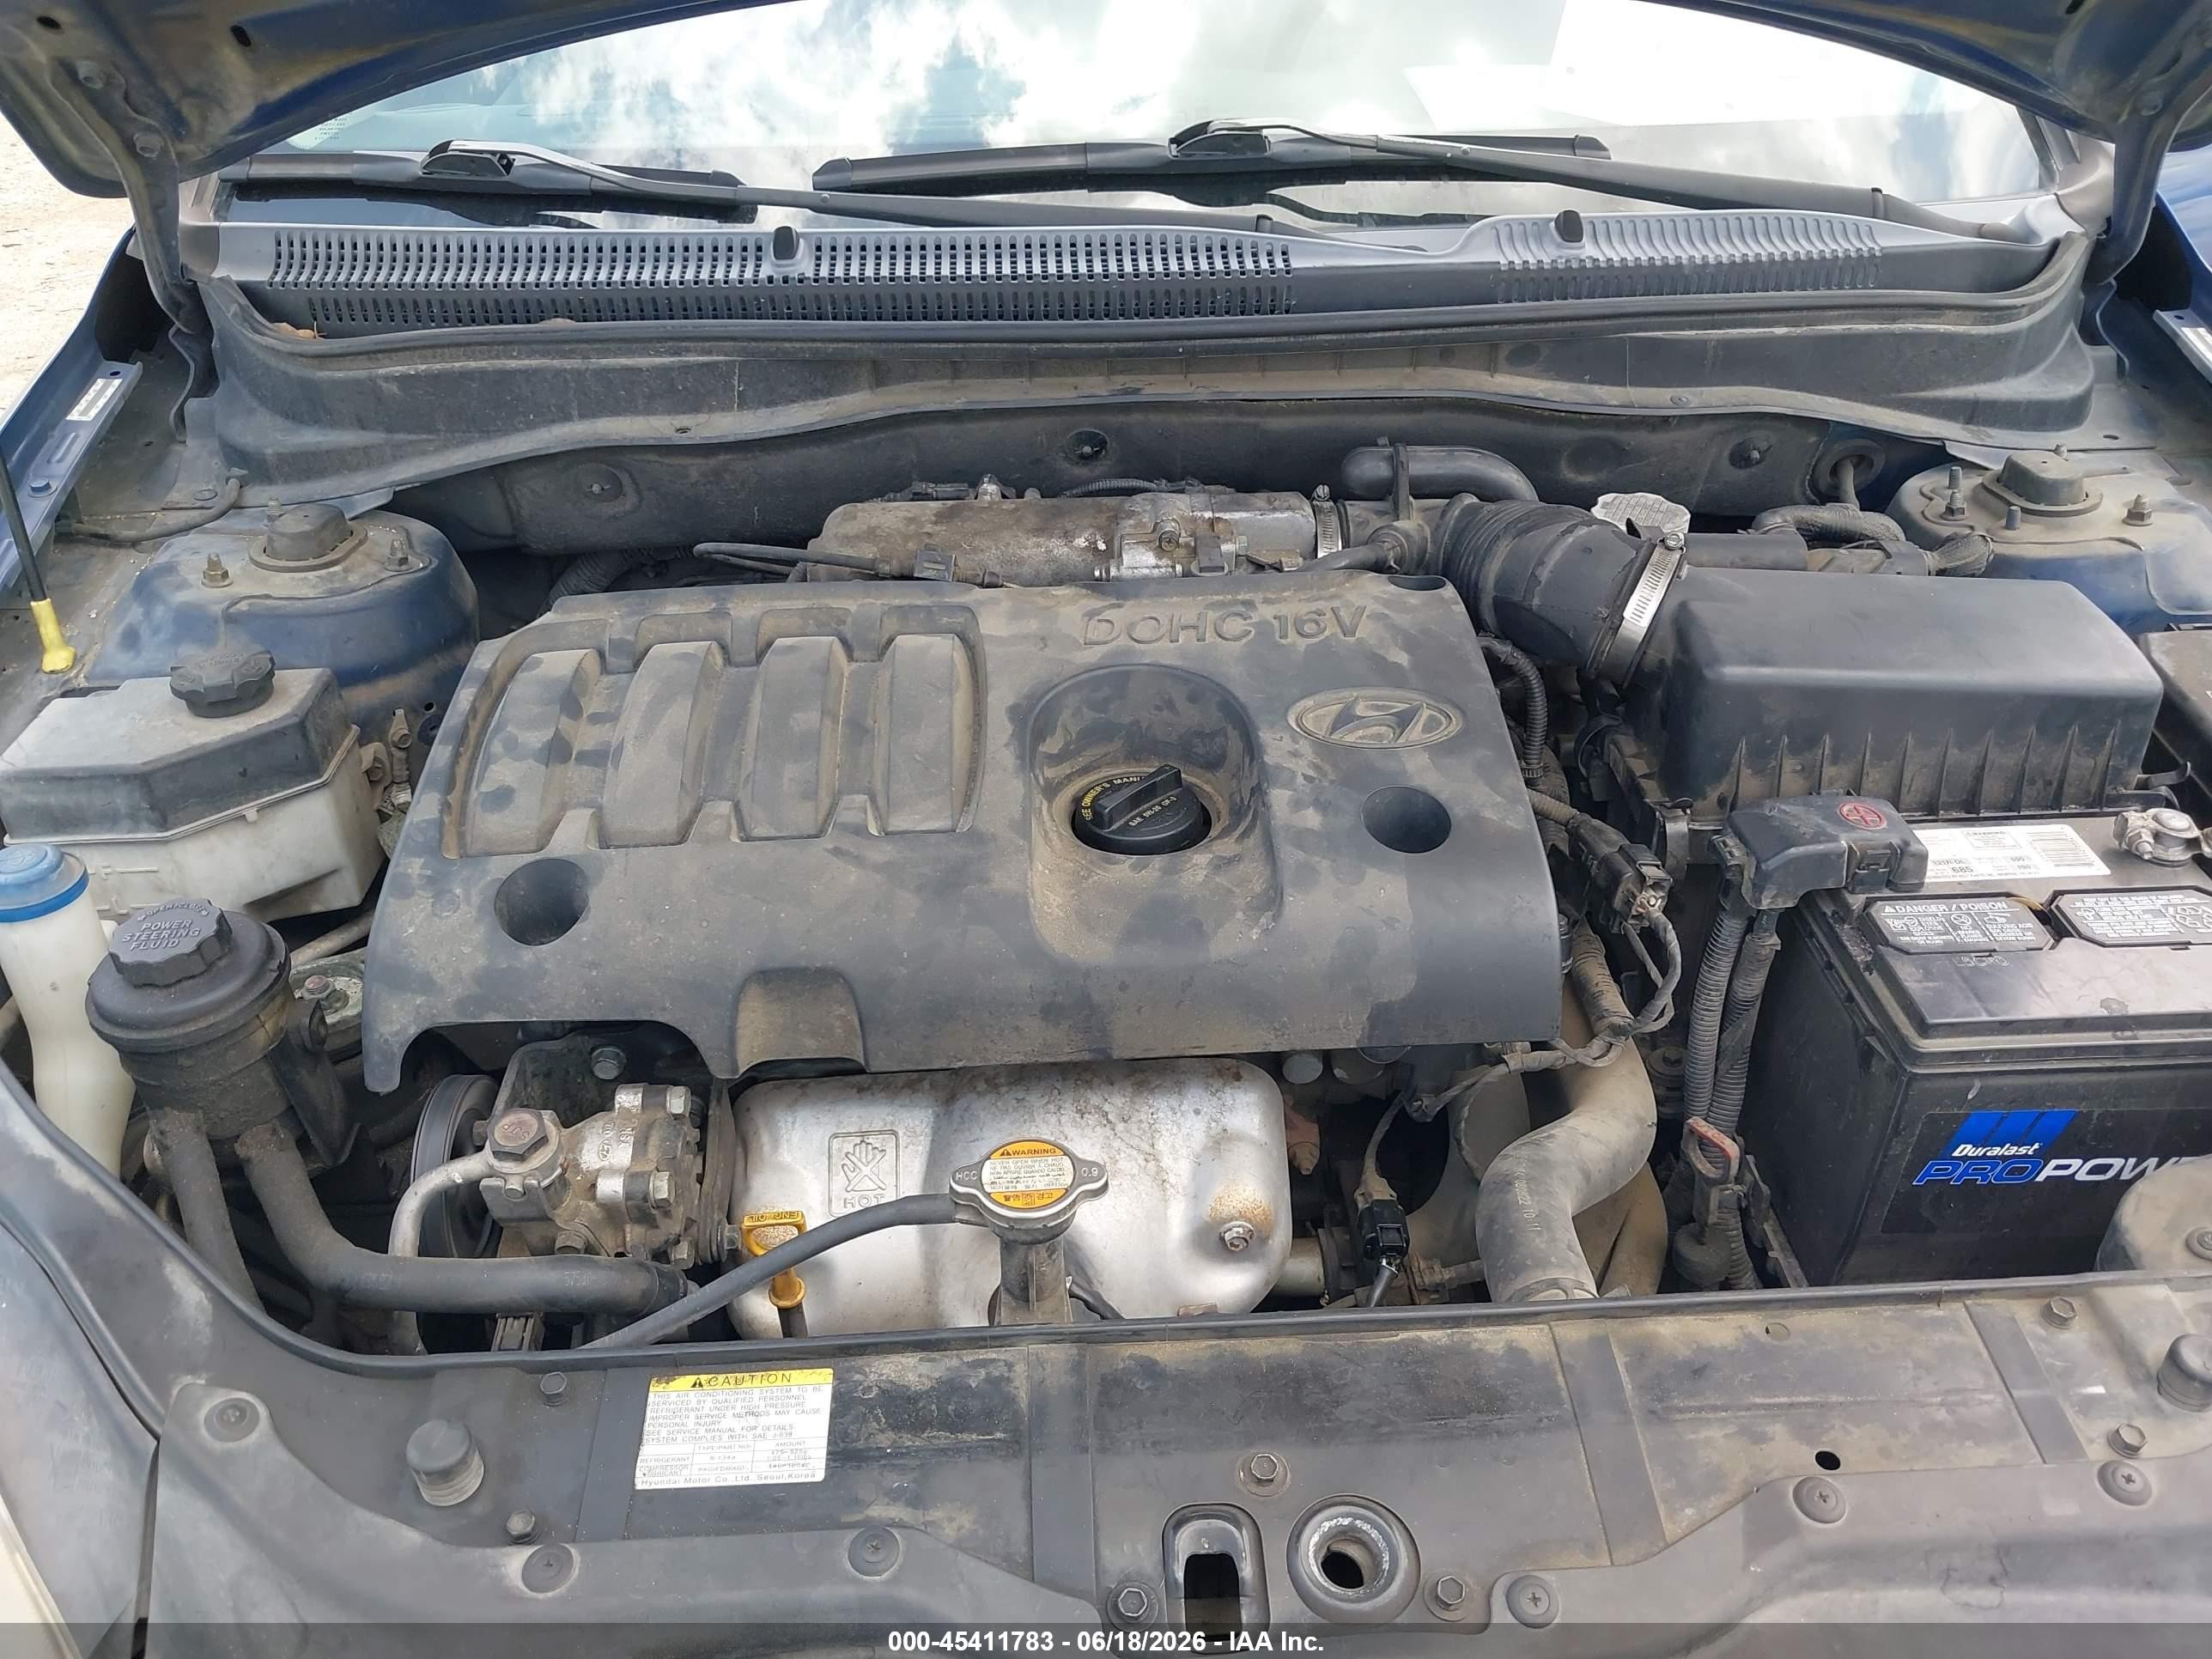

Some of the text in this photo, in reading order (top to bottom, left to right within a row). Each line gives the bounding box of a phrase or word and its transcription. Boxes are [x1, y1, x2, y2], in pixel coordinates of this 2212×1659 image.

[1083, 604, 1367, 647] DOHC 16V
[1082, 782, 1111, 807] OWNER'S
[1082, 808, 1093, 821] SEE
[1128, 817, 1145, 826] SAE
[1894, 904, 1948, 914] DANGER
[1961, 902, 2008, 911] POISON
[141, 920, 193, 931] POWER
[122, 928, 203, 942] STEERING
[130, 939, 180, 951] FLUID
[1951, 1141, 2039, 1157] Duralast
[955, 1170, 978, 1181] HCC
[1081, 1167, 1098, 1177] 0.9
[843, 1194, 885, 1209] HOT
[748, 1213, 766, 1223] OIL
[708, 1372, 792, 1388] CAUTION
[694, 1389, 754, 1398] CONDITIONING
[650, 1406, 704, 1414] REFRIGERANT
[764, 1401, 806, 1409] PRESSURE
[648, 1413, 690, 1422] IMPROPER
[732, 1410, 770, 1419] METHODS
[762, 1423, 793, 1431] DETAILS
[682, 1434, 722, 1443] COMPLIES
[640, 1455, 690, 1464] REFRIGERANT
[639, 1464, 689, 1473] COMPRESSOR
[641, 1478, 681, 1487] Hyundai
